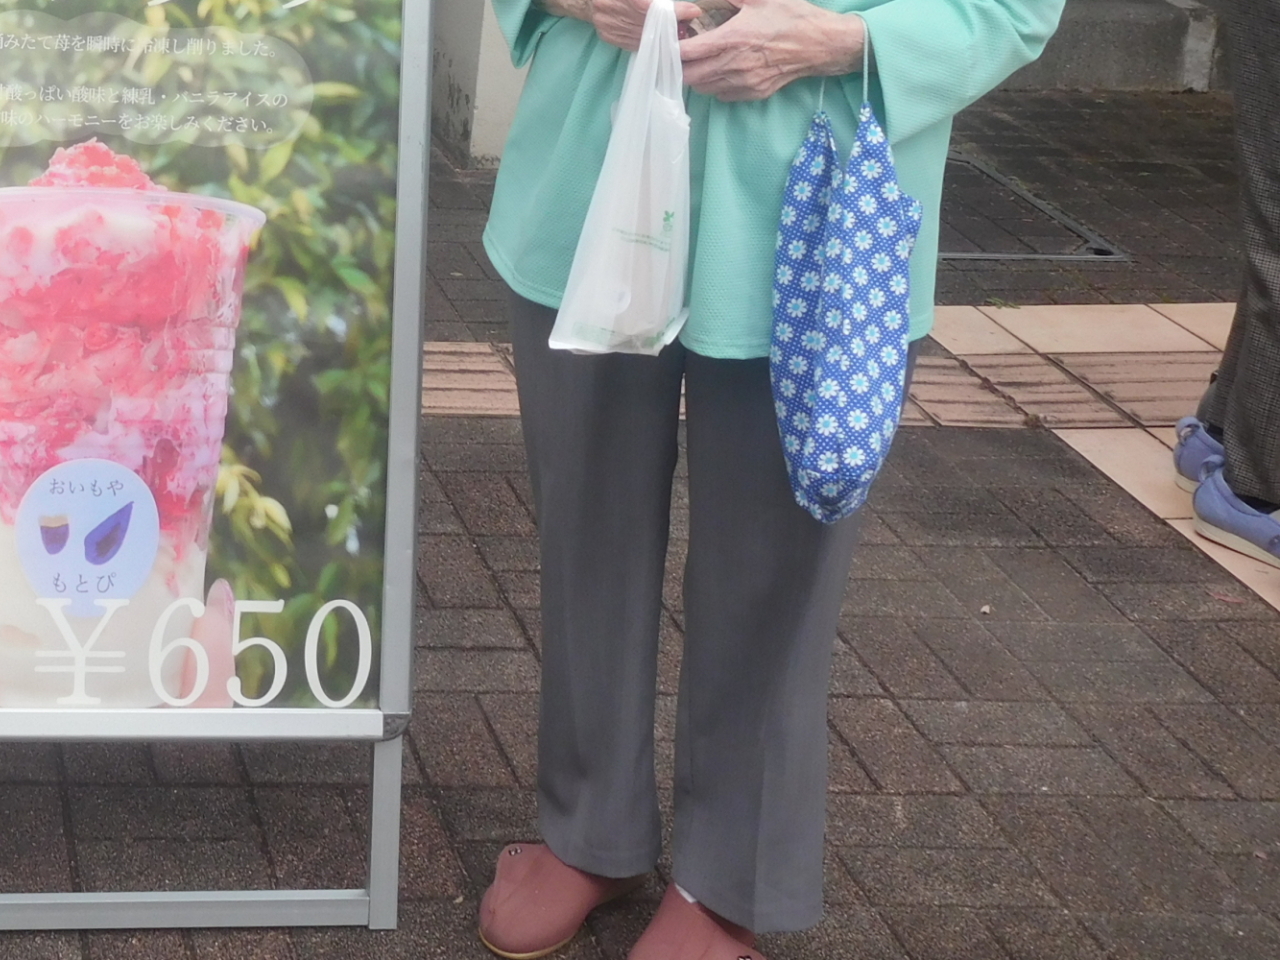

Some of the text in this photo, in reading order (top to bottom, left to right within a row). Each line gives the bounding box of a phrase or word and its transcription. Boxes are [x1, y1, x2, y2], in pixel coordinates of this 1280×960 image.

[49, 478, 124, 498] おいもや
[52, 571, 117, 593] もとぴ
[35, 597, 372, 708] ¥650
